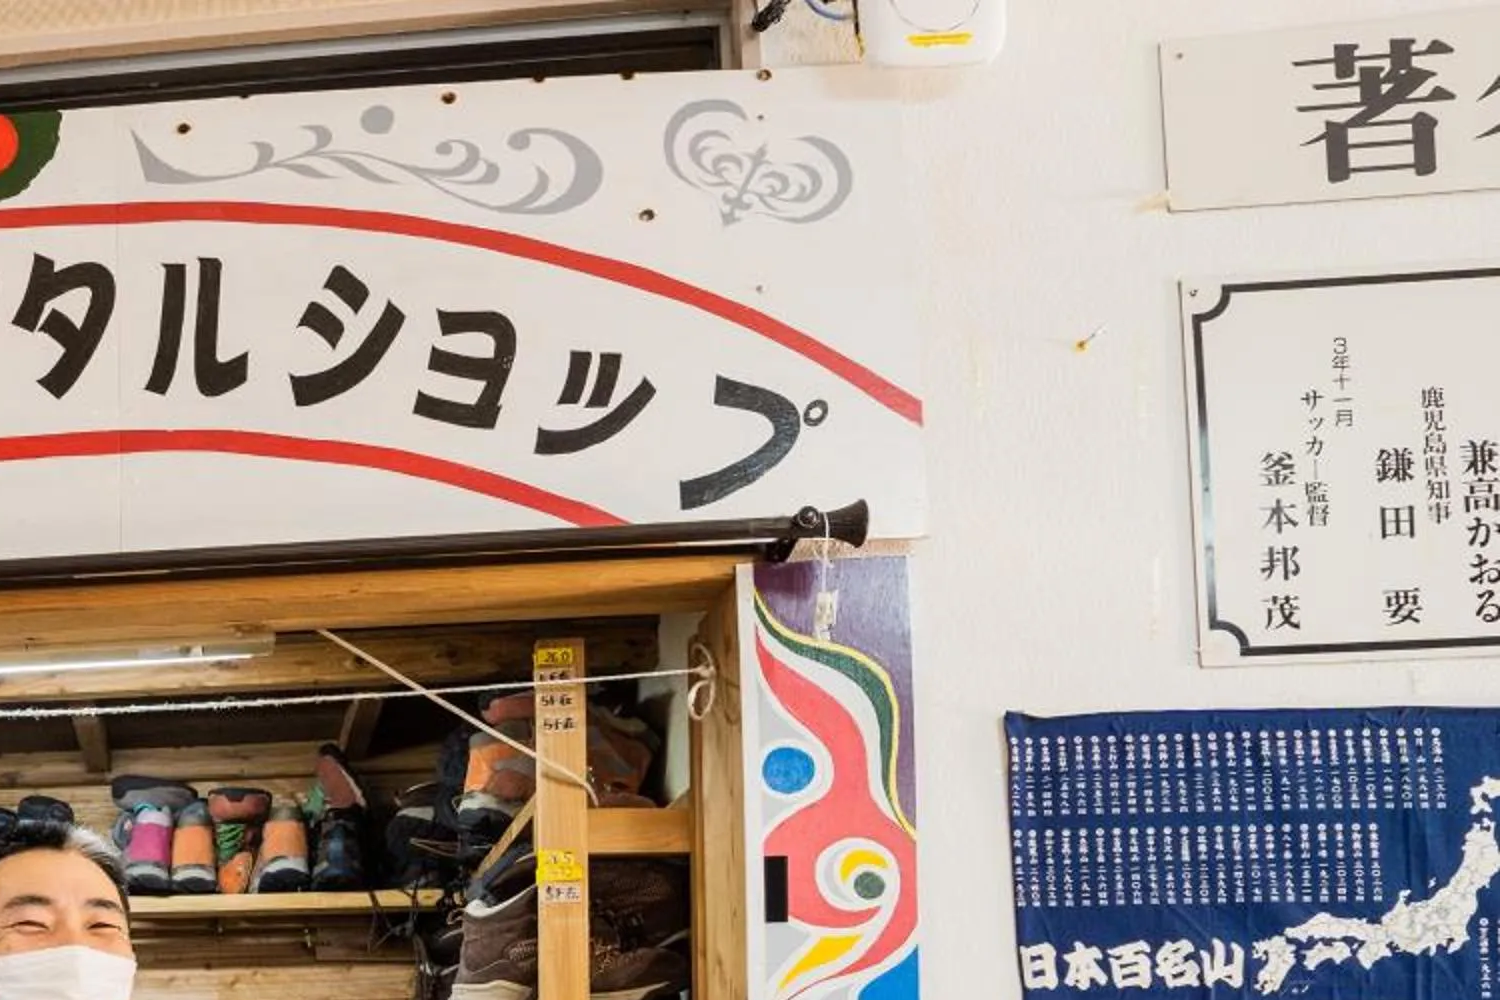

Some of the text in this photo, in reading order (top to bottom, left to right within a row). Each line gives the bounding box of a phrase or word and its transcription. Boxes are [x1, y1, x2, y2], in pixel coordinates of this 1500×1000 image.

[1292, 37, 1500, 184] 著
[1300, 389, 1330, 527] サッカー監督
[1421, 386, 1452, 525] 鹿児島県知事
[1260, 451, 1301, 631] 釜本邦茂
[1020, 937, 1244, 991] 日本百名山
